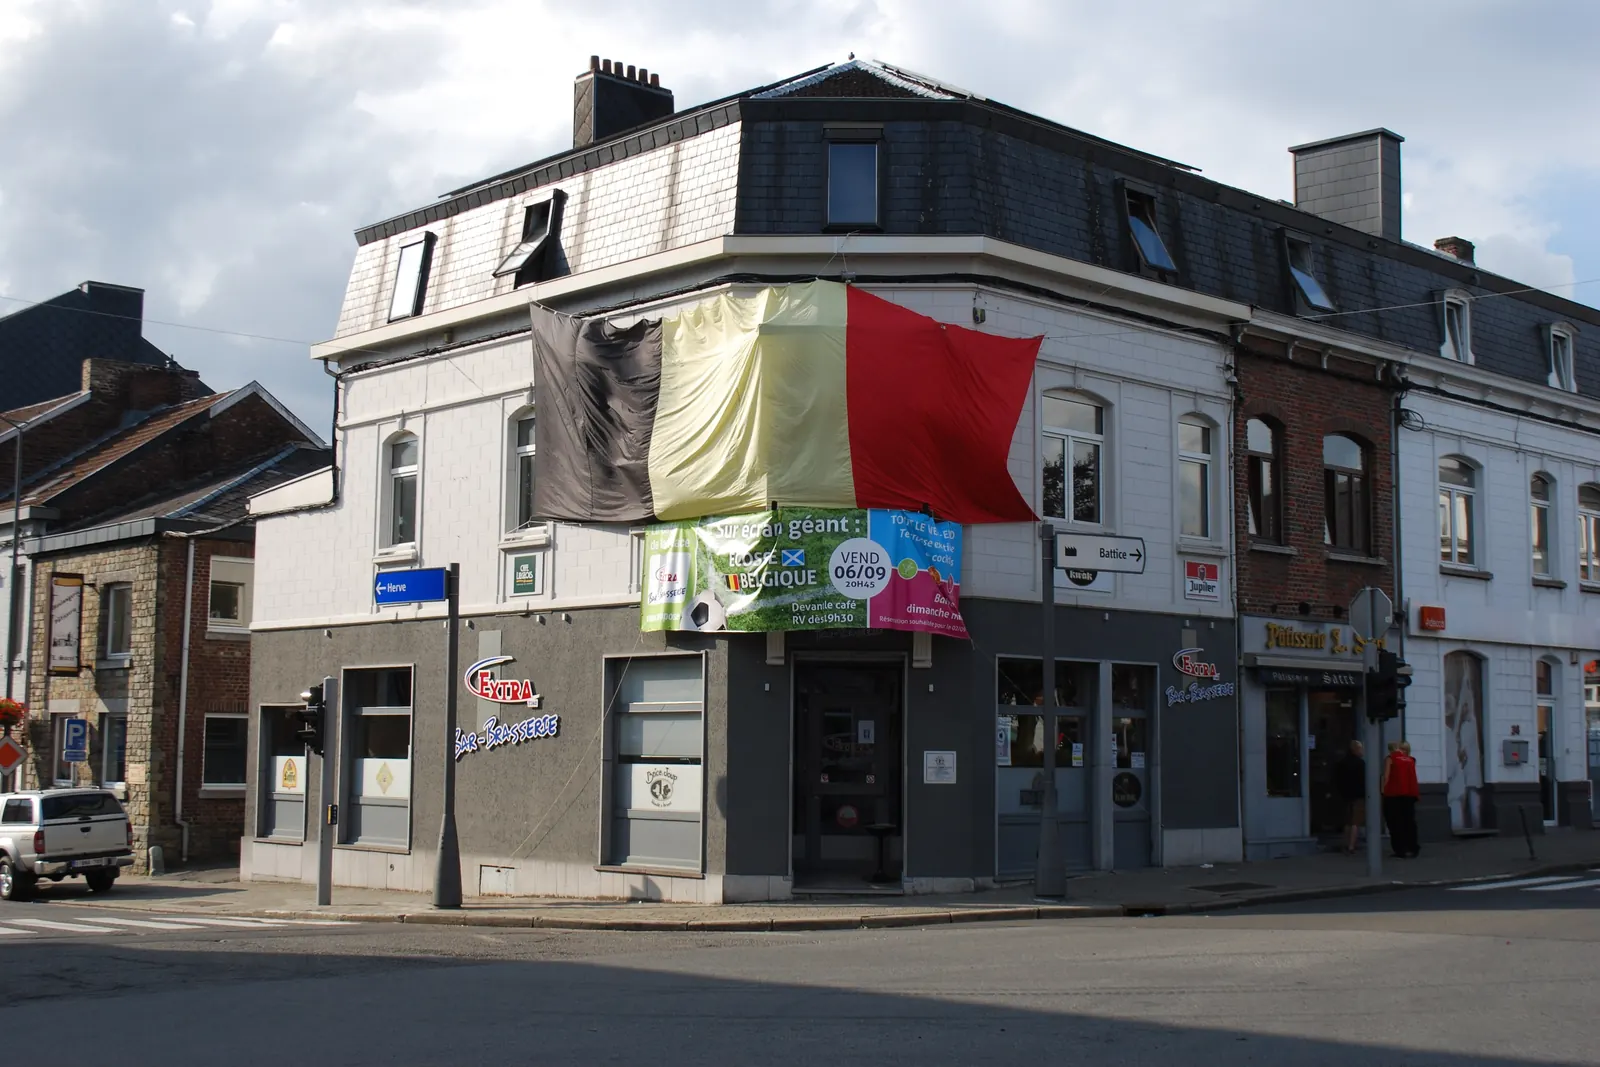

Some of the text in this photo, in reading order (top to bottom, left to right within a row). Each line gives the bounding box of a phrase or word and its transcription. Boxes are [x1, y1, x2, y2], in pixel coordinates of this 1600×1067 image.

[715, 523, 739, 541] Sur
[741, 519, 783, 540] écran
[788, 514, 849, 541] géant
[840, 551, 880, 565] VEND
[1100, 547, 1127, 560] Battice
[834, 564, 886, 581] 06/09
[740, 570, 818, 590] BELGIQUE
[845, 580, 876, 589] 20H45
[1189, 580, 1216, 593] Jupiler
[387, 582, 407, 593] Herve
[791, 602, 824, 613] Devan
[835, 599, 857, 611] café
[907, 603, 950, 619] dimanche
[792, 615, 806, 625] RV
